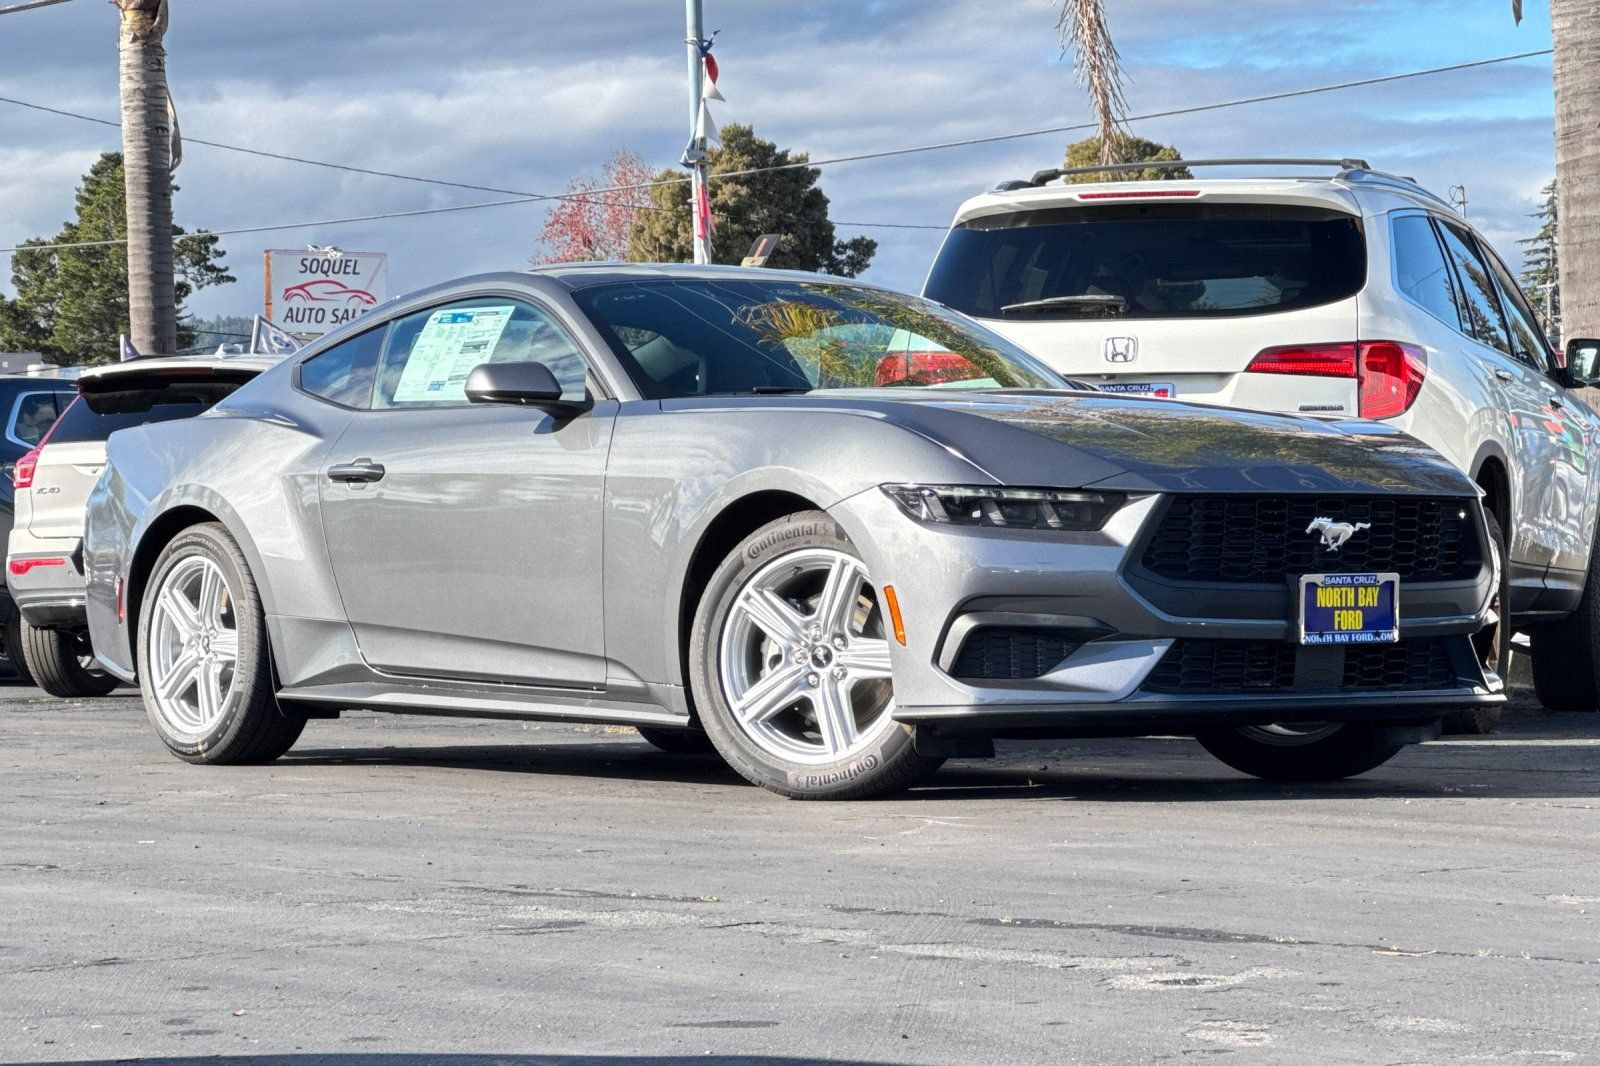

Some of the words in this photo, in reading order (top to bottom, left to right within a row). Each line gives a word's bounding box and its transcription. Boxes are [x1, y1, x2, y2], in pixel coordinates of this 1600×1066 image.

[299, 257, 360, 277] SOQUEL
[283, 307, 326, 324] AUTO
[330, 307, 369, 324] SAL
[1127, 384, 1149, 392] CRUZ
[747, 522, 818, 559] Continental
[1324, 575, 1352, 585] SANTA
[1353, 575, 1376, 584] CRUZ
[1316, 586, 1355, 608] NORTH
[1357, 586, 1380, 607] BAY
[1334, 610, 1363, 631] FORD
[1334, 633, 1350, 642] BAY
[805, 754, 879, 789] Continental
